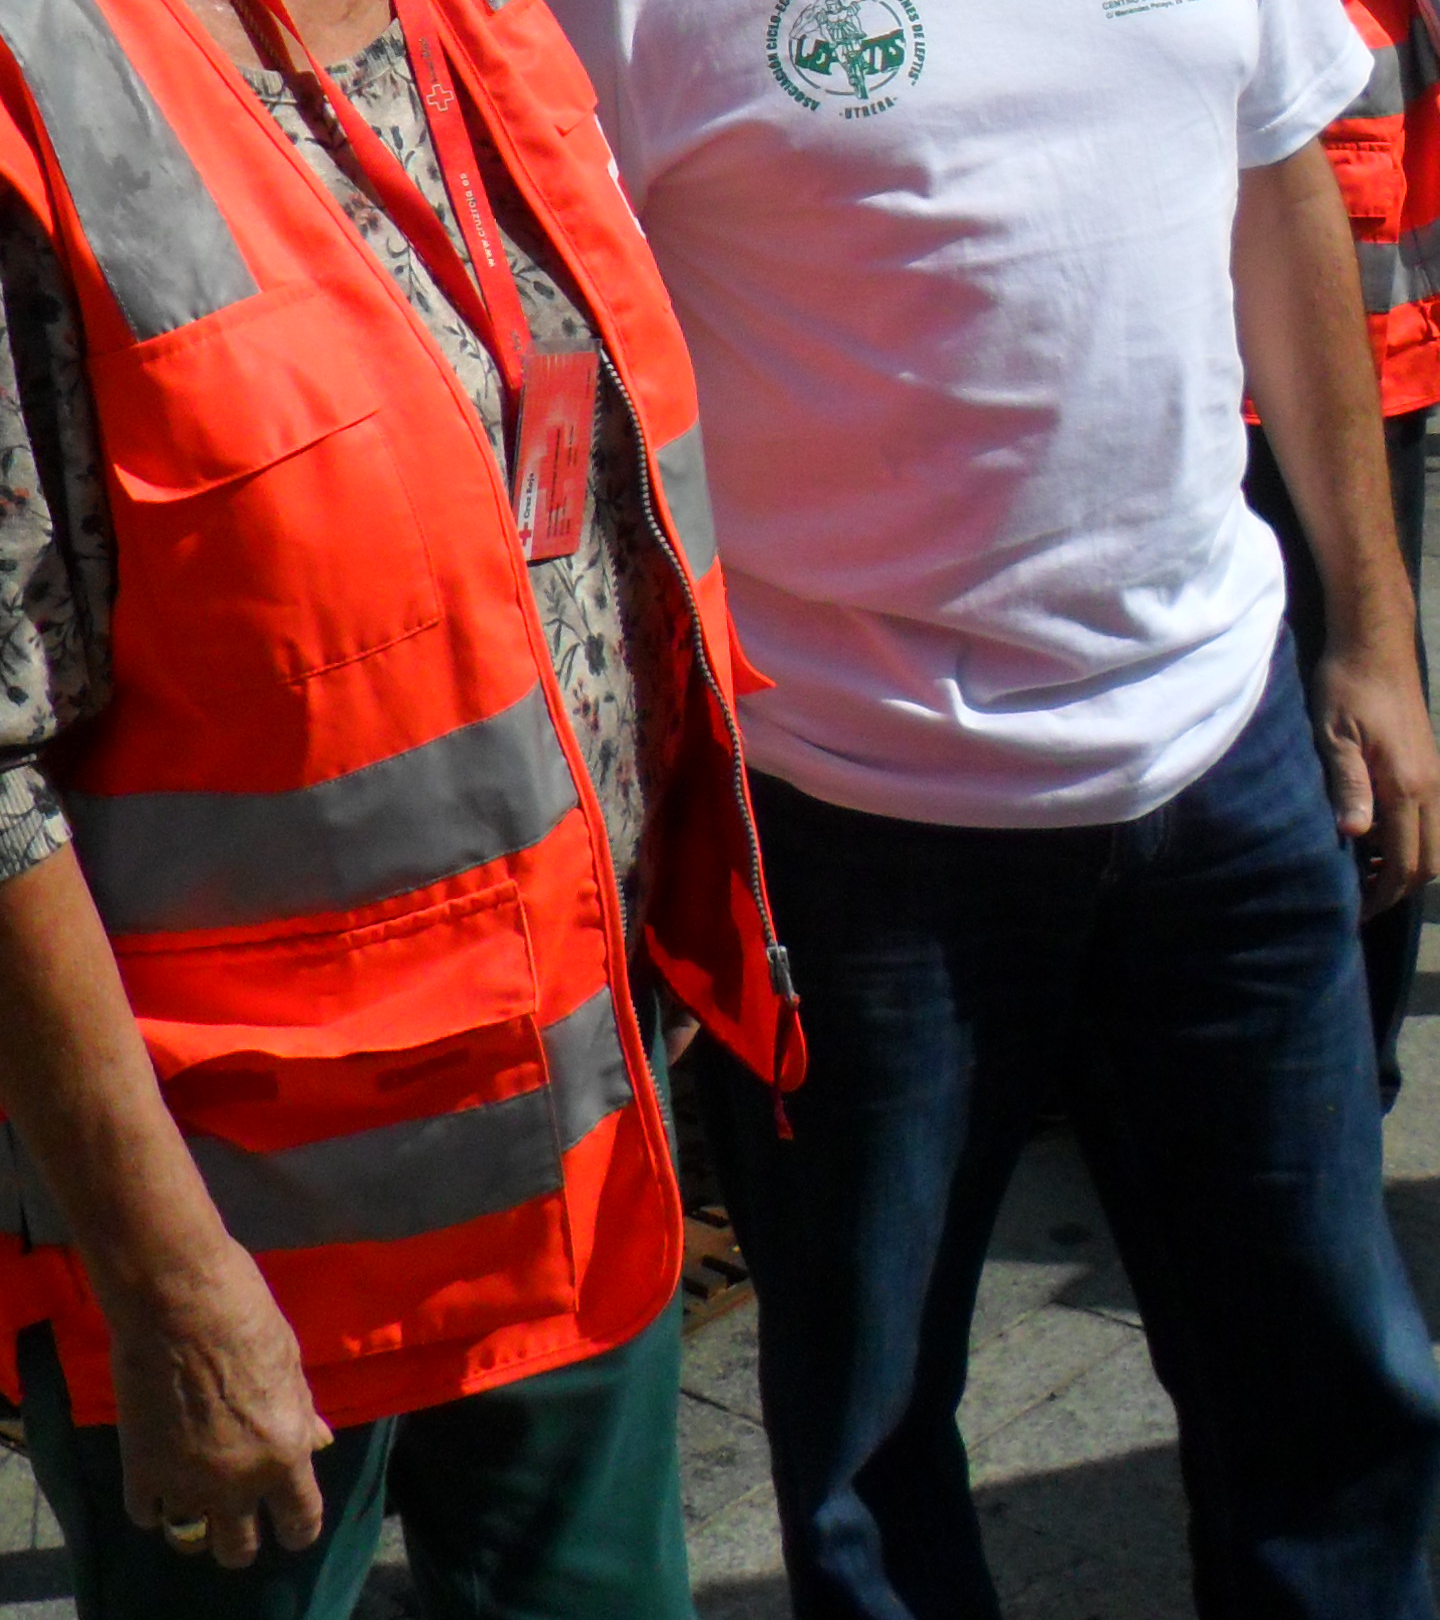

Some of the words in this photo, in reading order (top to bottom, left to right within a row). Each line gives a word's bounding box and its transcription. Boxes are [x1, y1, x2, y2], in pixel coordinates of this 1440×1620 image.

[911, 23, 925, 39] DE
[525, 472, 535, 494] Roja
[523, 497, 532, 519] Cruz
